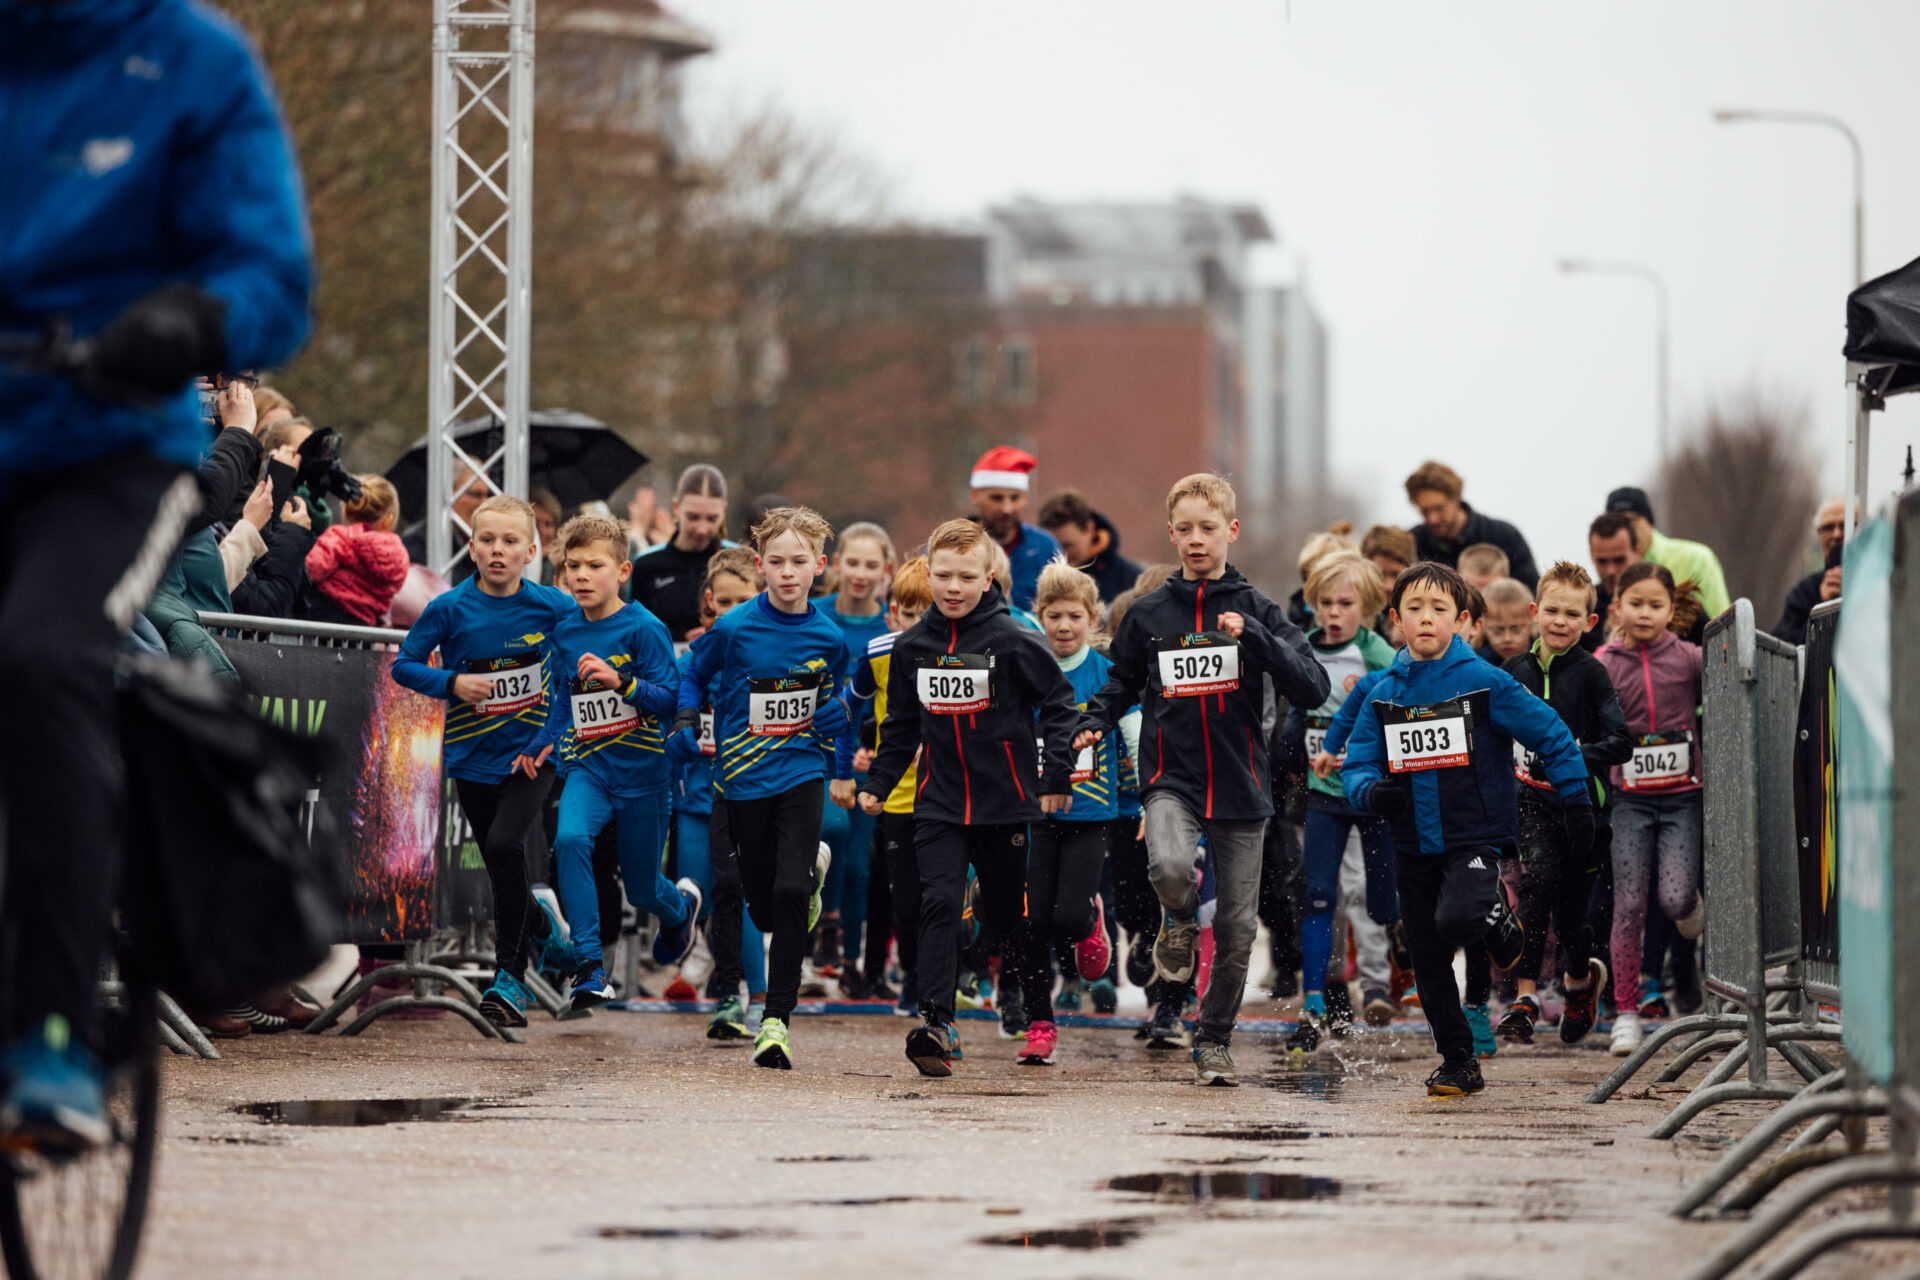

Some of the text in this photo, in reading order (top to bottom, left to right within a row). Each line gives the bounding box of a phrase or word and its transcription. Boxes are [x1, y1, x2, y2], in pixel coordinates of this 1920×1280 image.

[1173, 654, 1223, 680] 5029
[929, 676, 975, 699] 5028
[578, 696, 622, 723] 5012
[765, 697, 811, 720] 5035
[1400, 726, 1451, 754] 5033
[1404, 755, 1465, 768] Wintermarathon.frl
[1634, 751, 1677, 774] 5042
